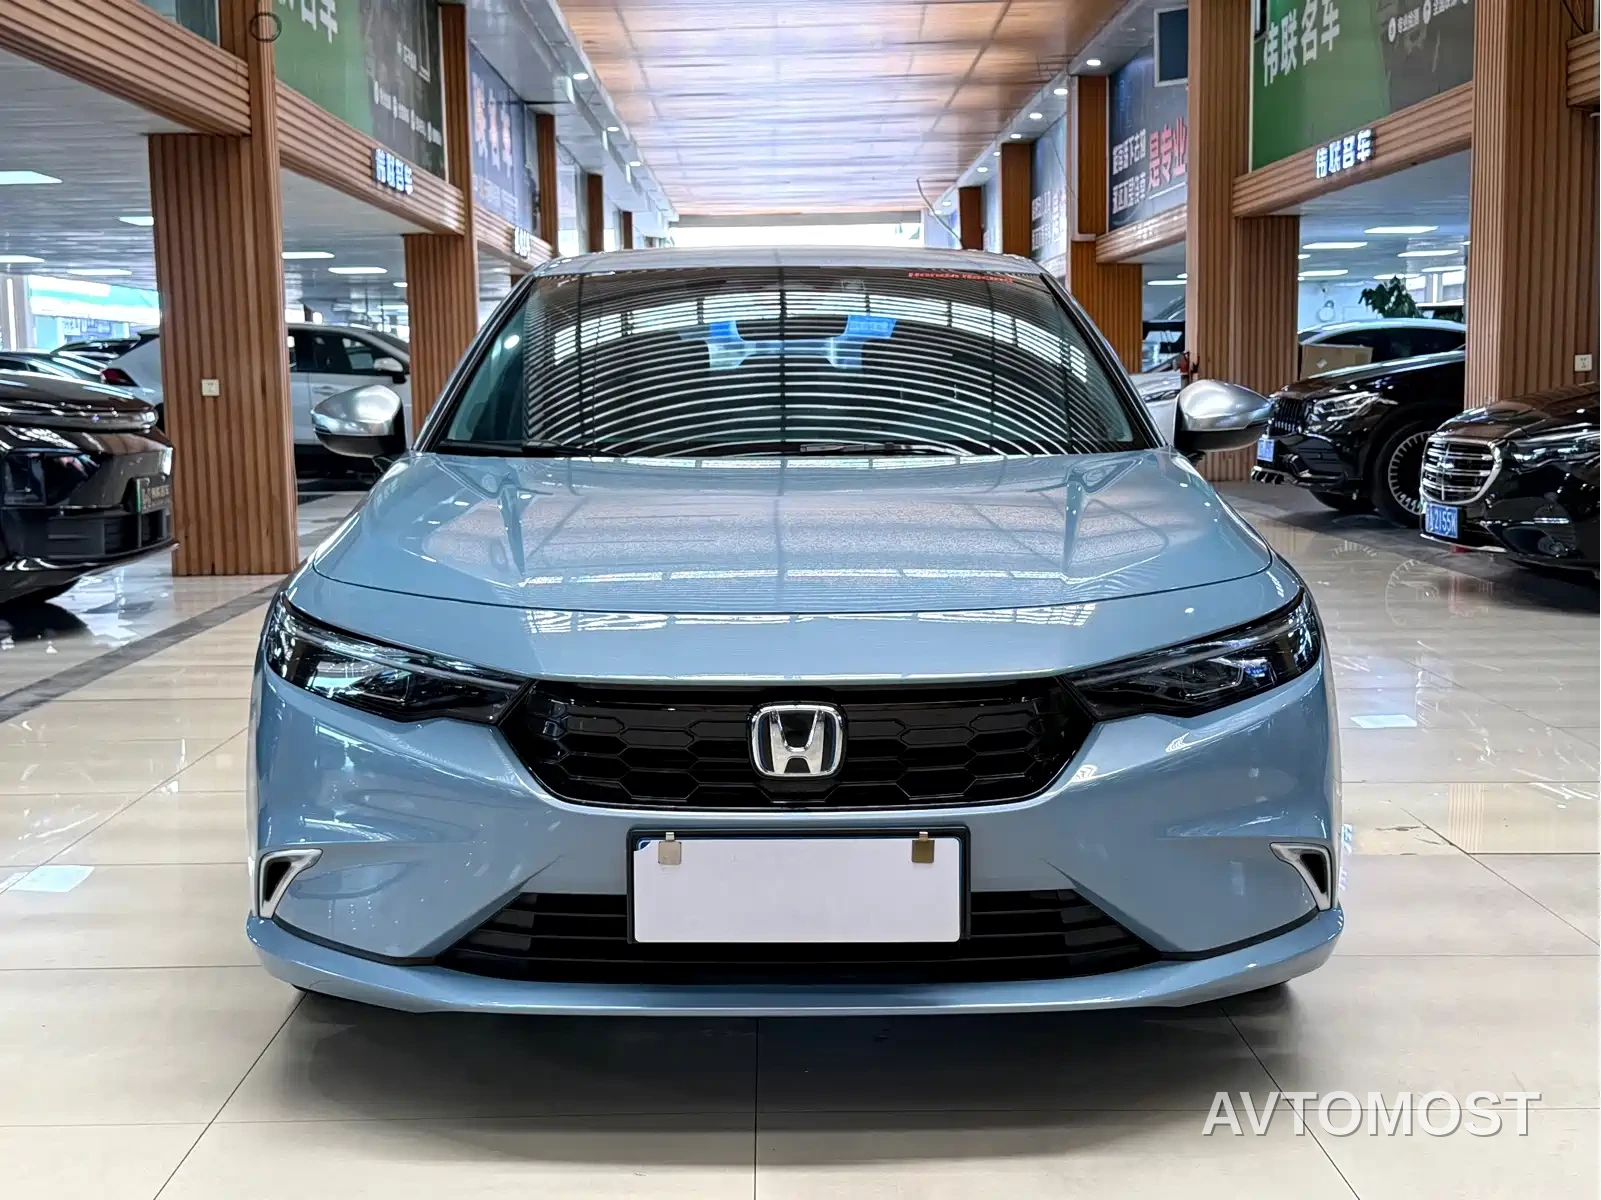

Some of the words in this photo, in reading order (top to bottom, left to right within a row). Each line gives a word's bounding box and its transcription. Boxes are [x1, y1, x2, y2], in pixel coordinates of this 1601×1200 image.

[1263, 0, 1341, 87] 伟联名车
[1316, 129, 1371, 179] 伟联名车
